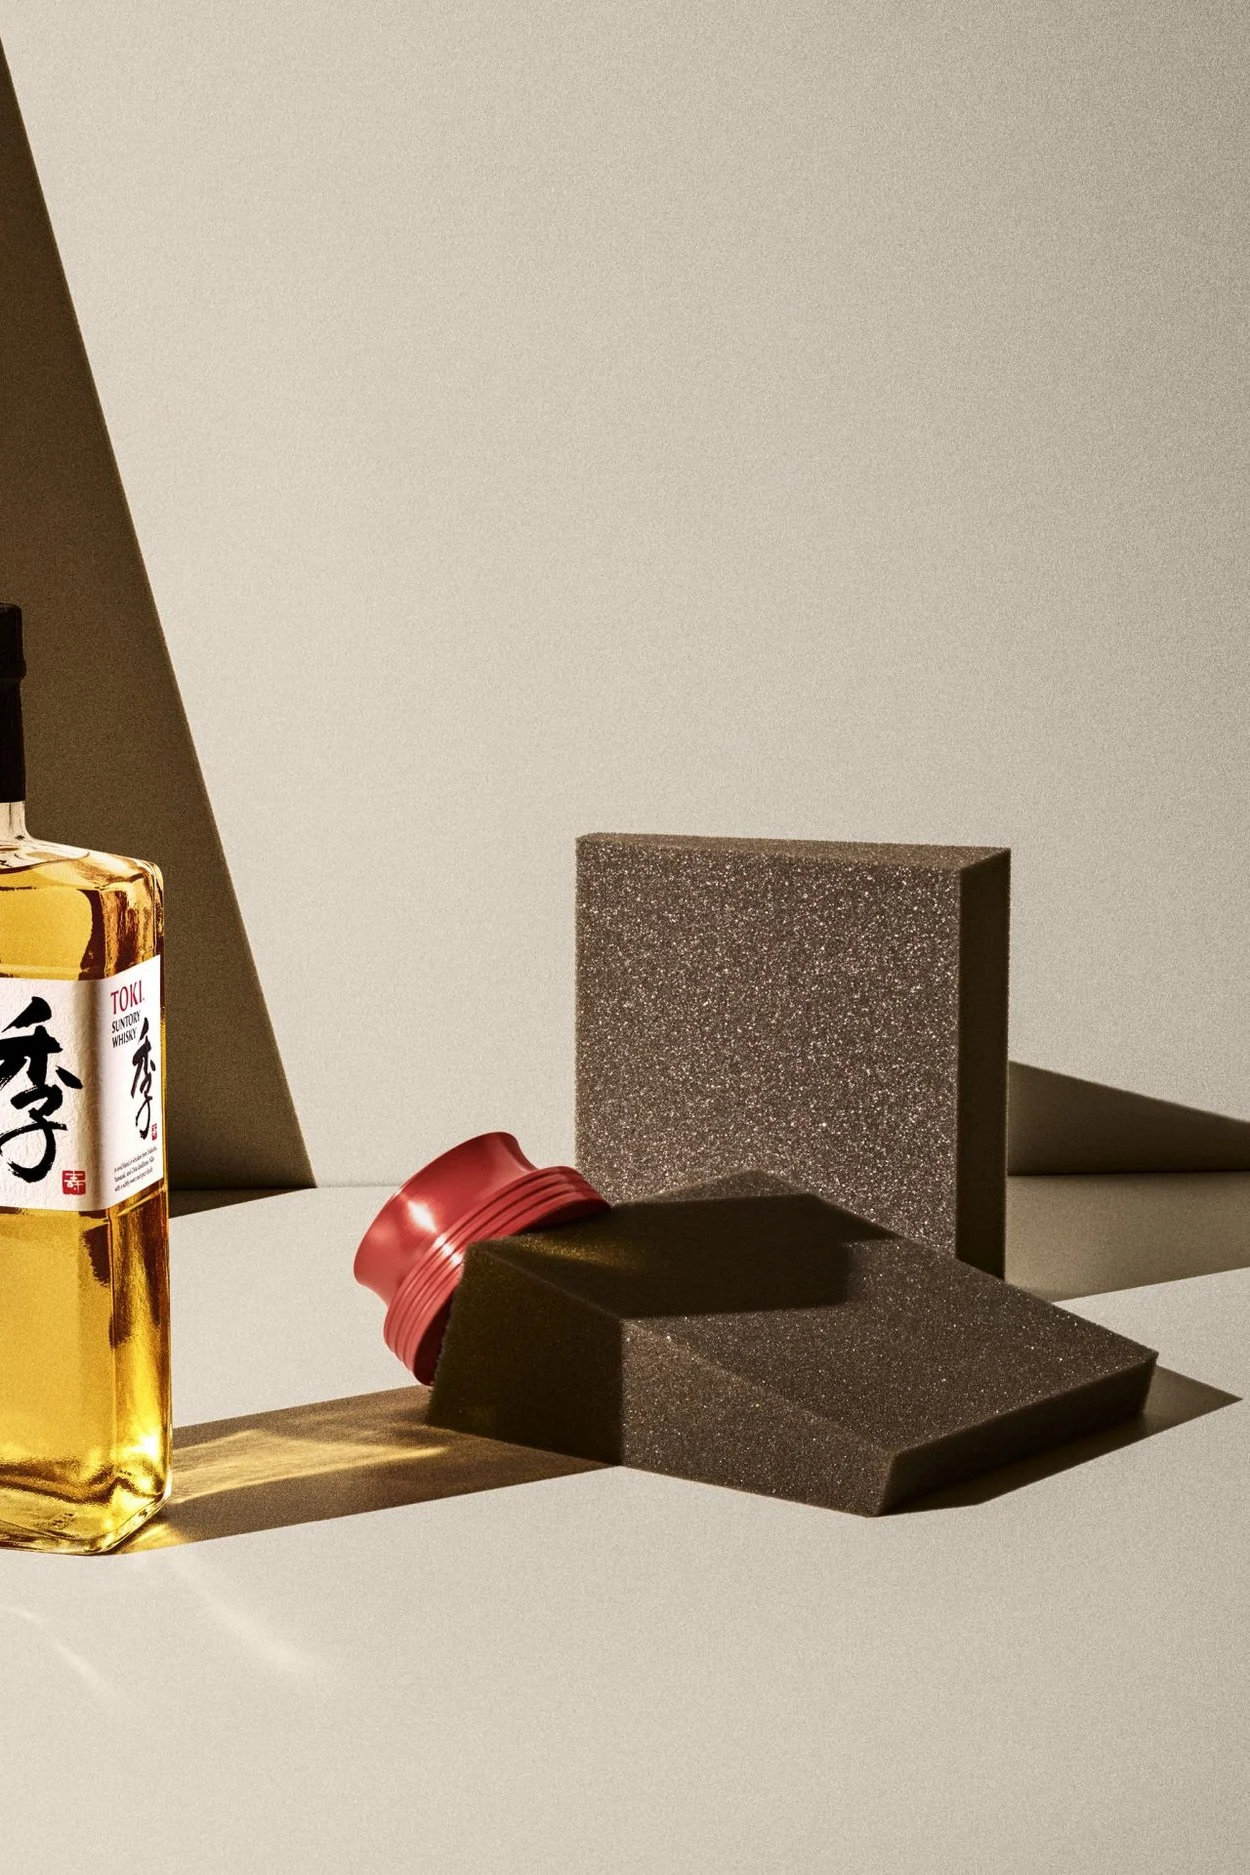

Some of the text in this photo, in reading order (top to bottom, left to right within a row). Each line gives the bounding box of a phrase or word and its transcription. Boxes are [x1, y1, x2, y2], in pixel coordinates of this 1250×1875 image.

[111, 980, 143, 1015] TOKI
[112, 1010, 141, 1034] SUNTORY
[112, 1027, 138, 1048] WHISKY
